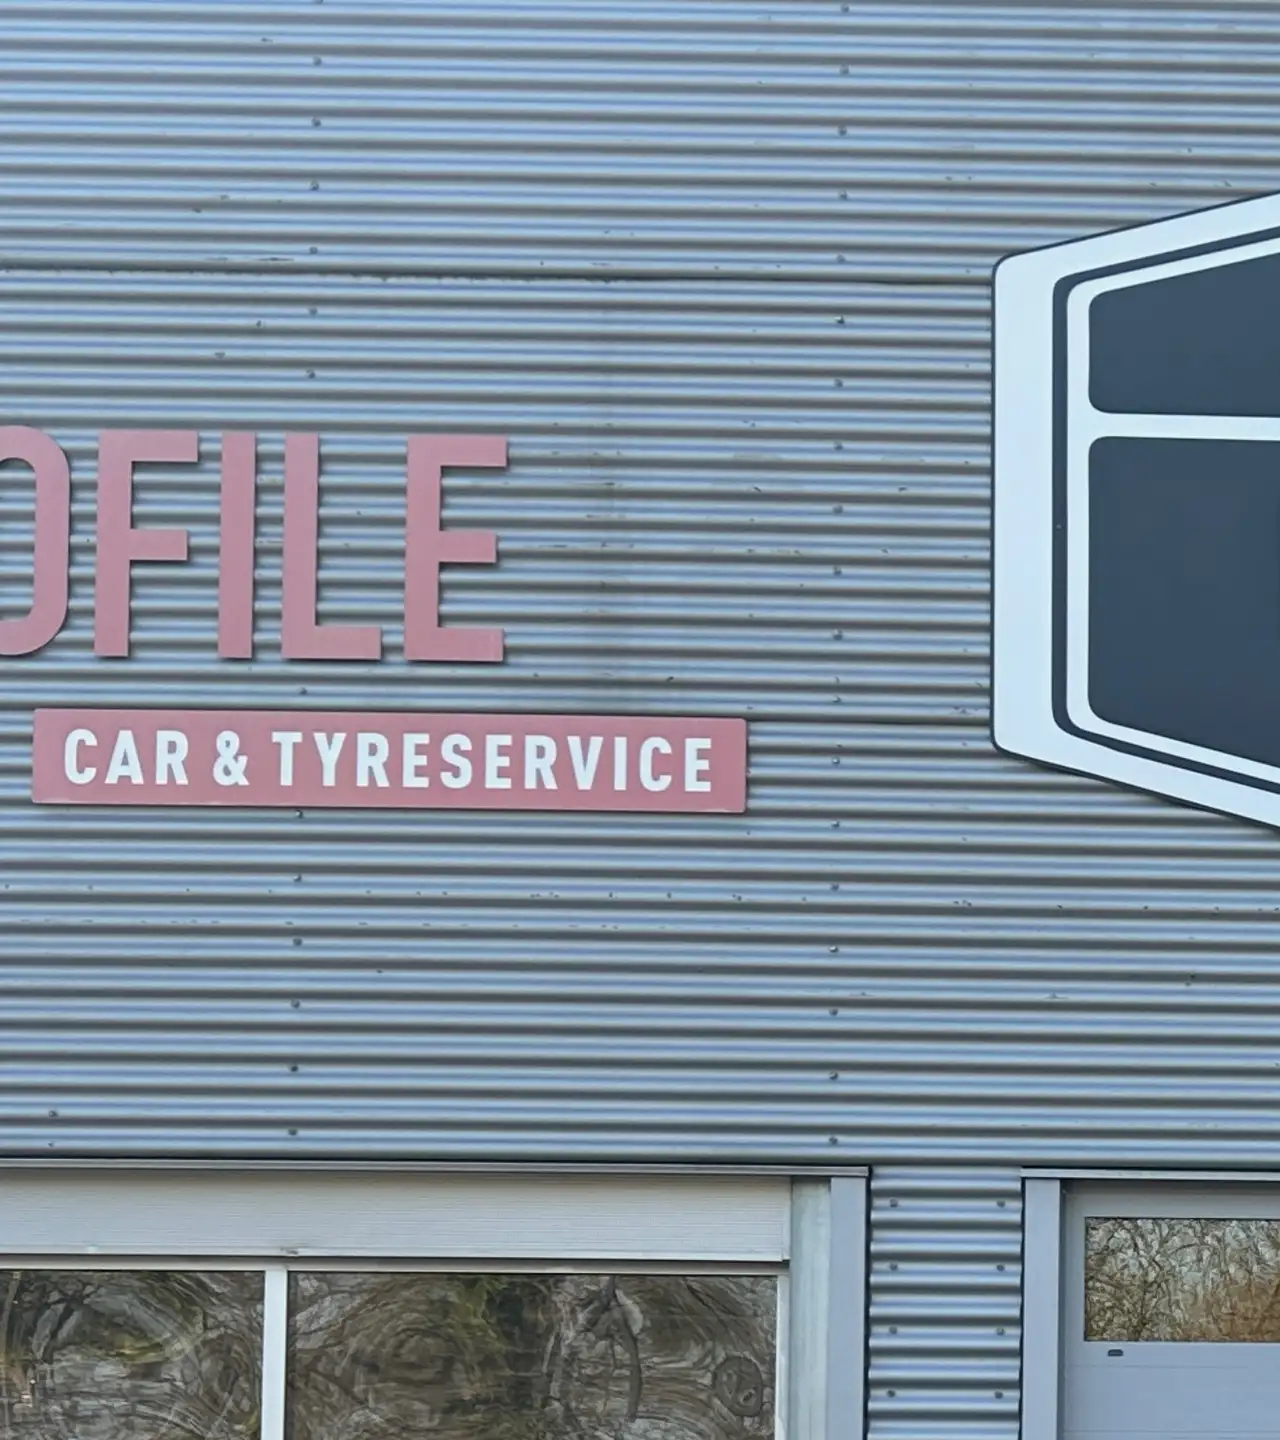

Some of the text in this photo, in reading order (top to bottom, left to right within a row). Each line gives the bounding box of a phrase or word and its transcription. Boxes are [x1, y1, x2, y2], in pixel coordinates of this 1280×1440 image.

[64, 728, 712, 792] CAR & TYRESERVICE
